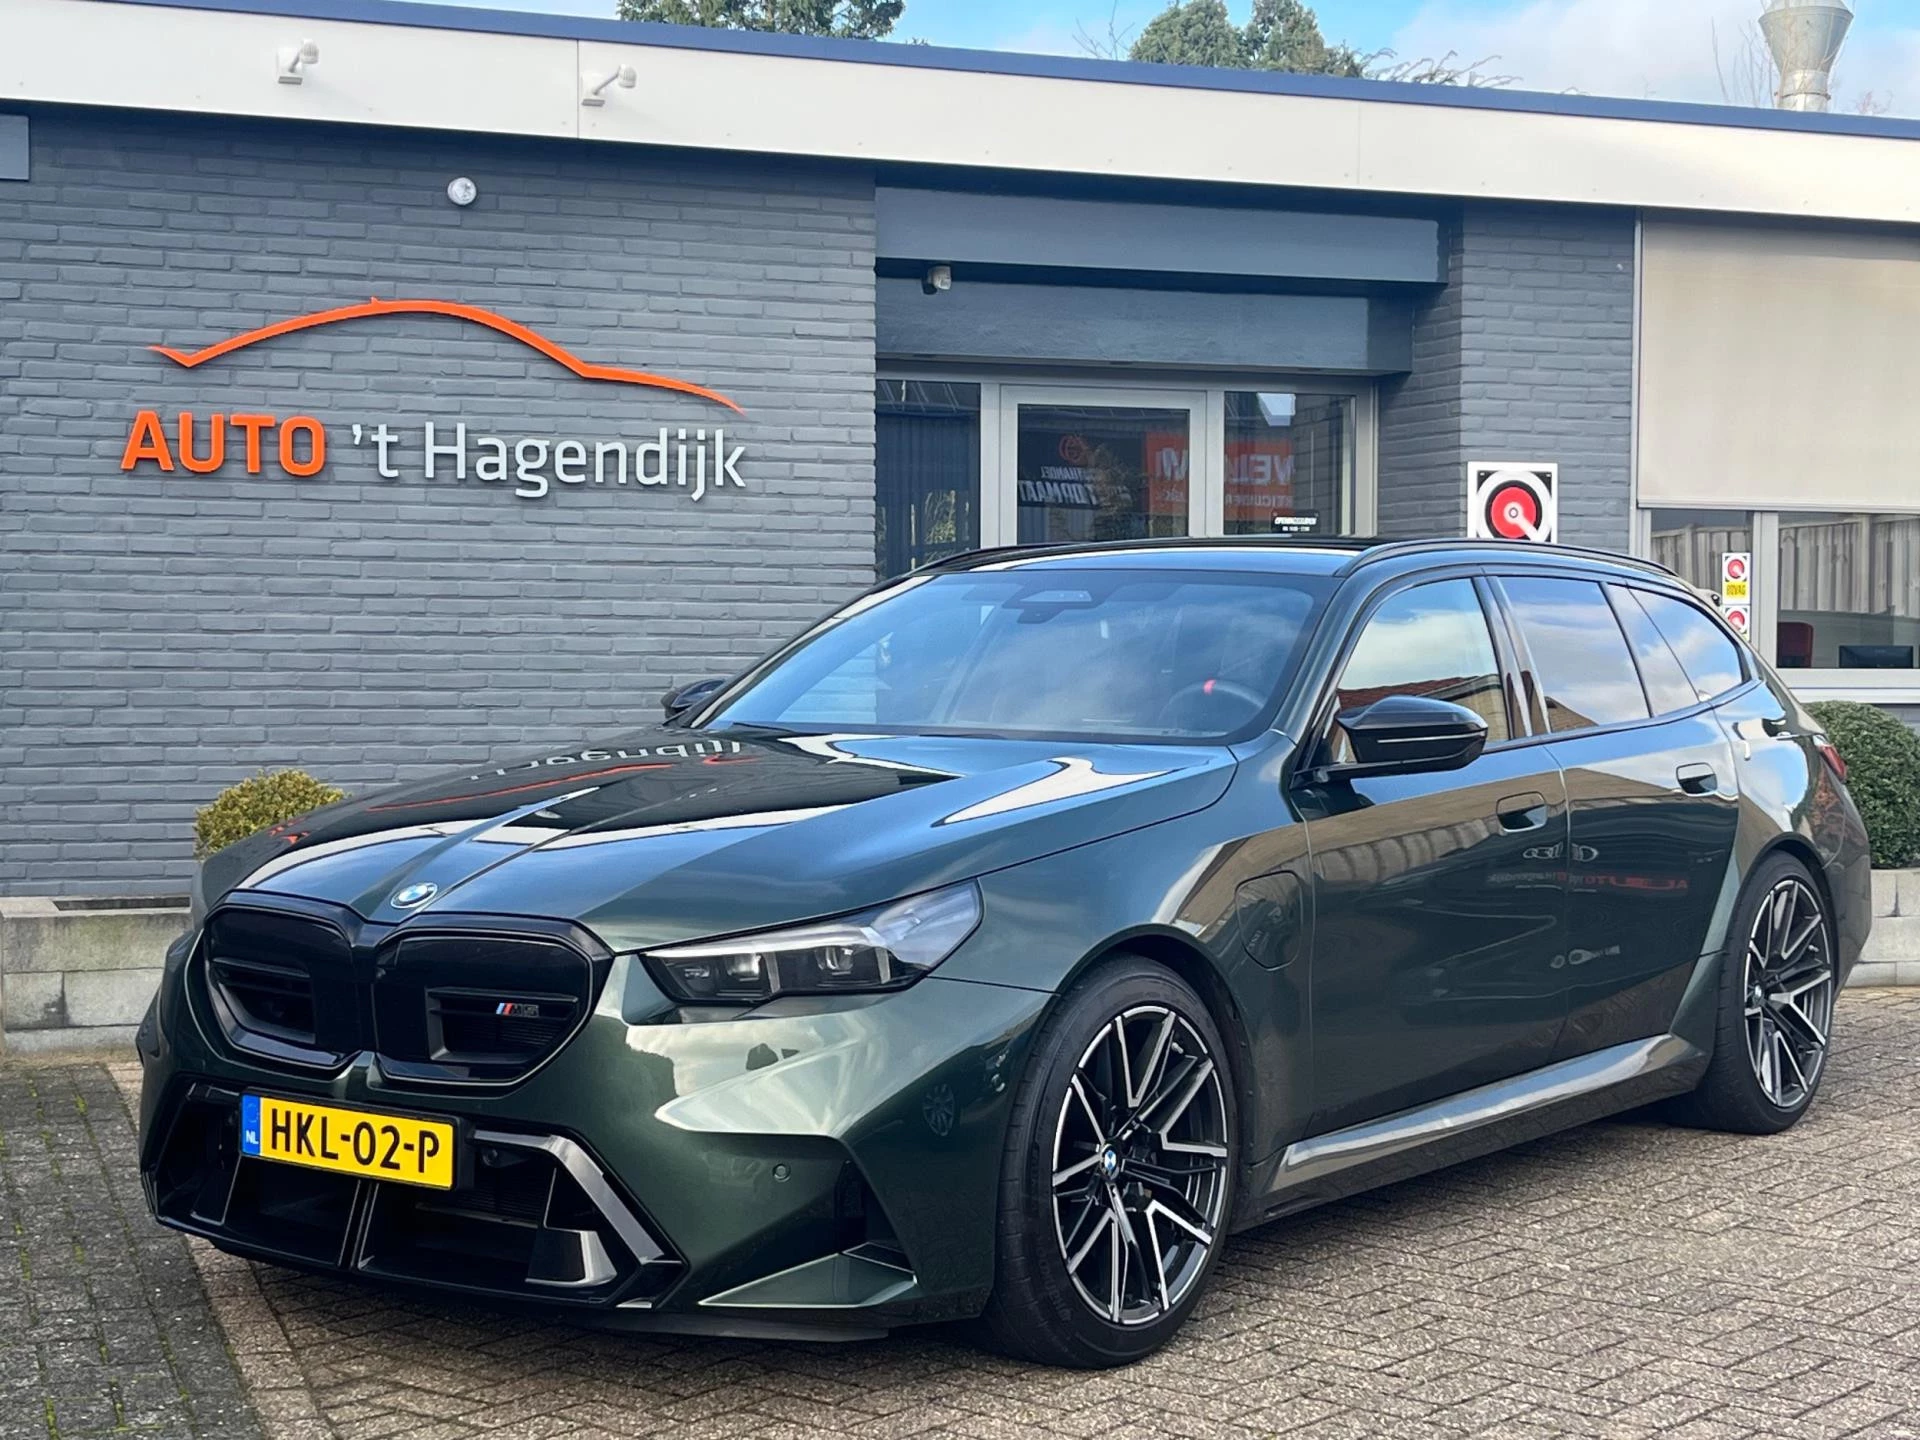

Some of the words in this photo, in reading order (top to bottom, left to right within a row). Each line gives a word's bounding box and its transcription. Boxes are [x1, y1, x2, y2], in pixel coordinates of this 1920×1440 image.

[120, 409, 327, 477] AUTO
[423, 421, 746, 502] Hagendijk
[245, 1129, 259, 1145] NL
[271, 1107, 440, 1174] HKL-02-P
